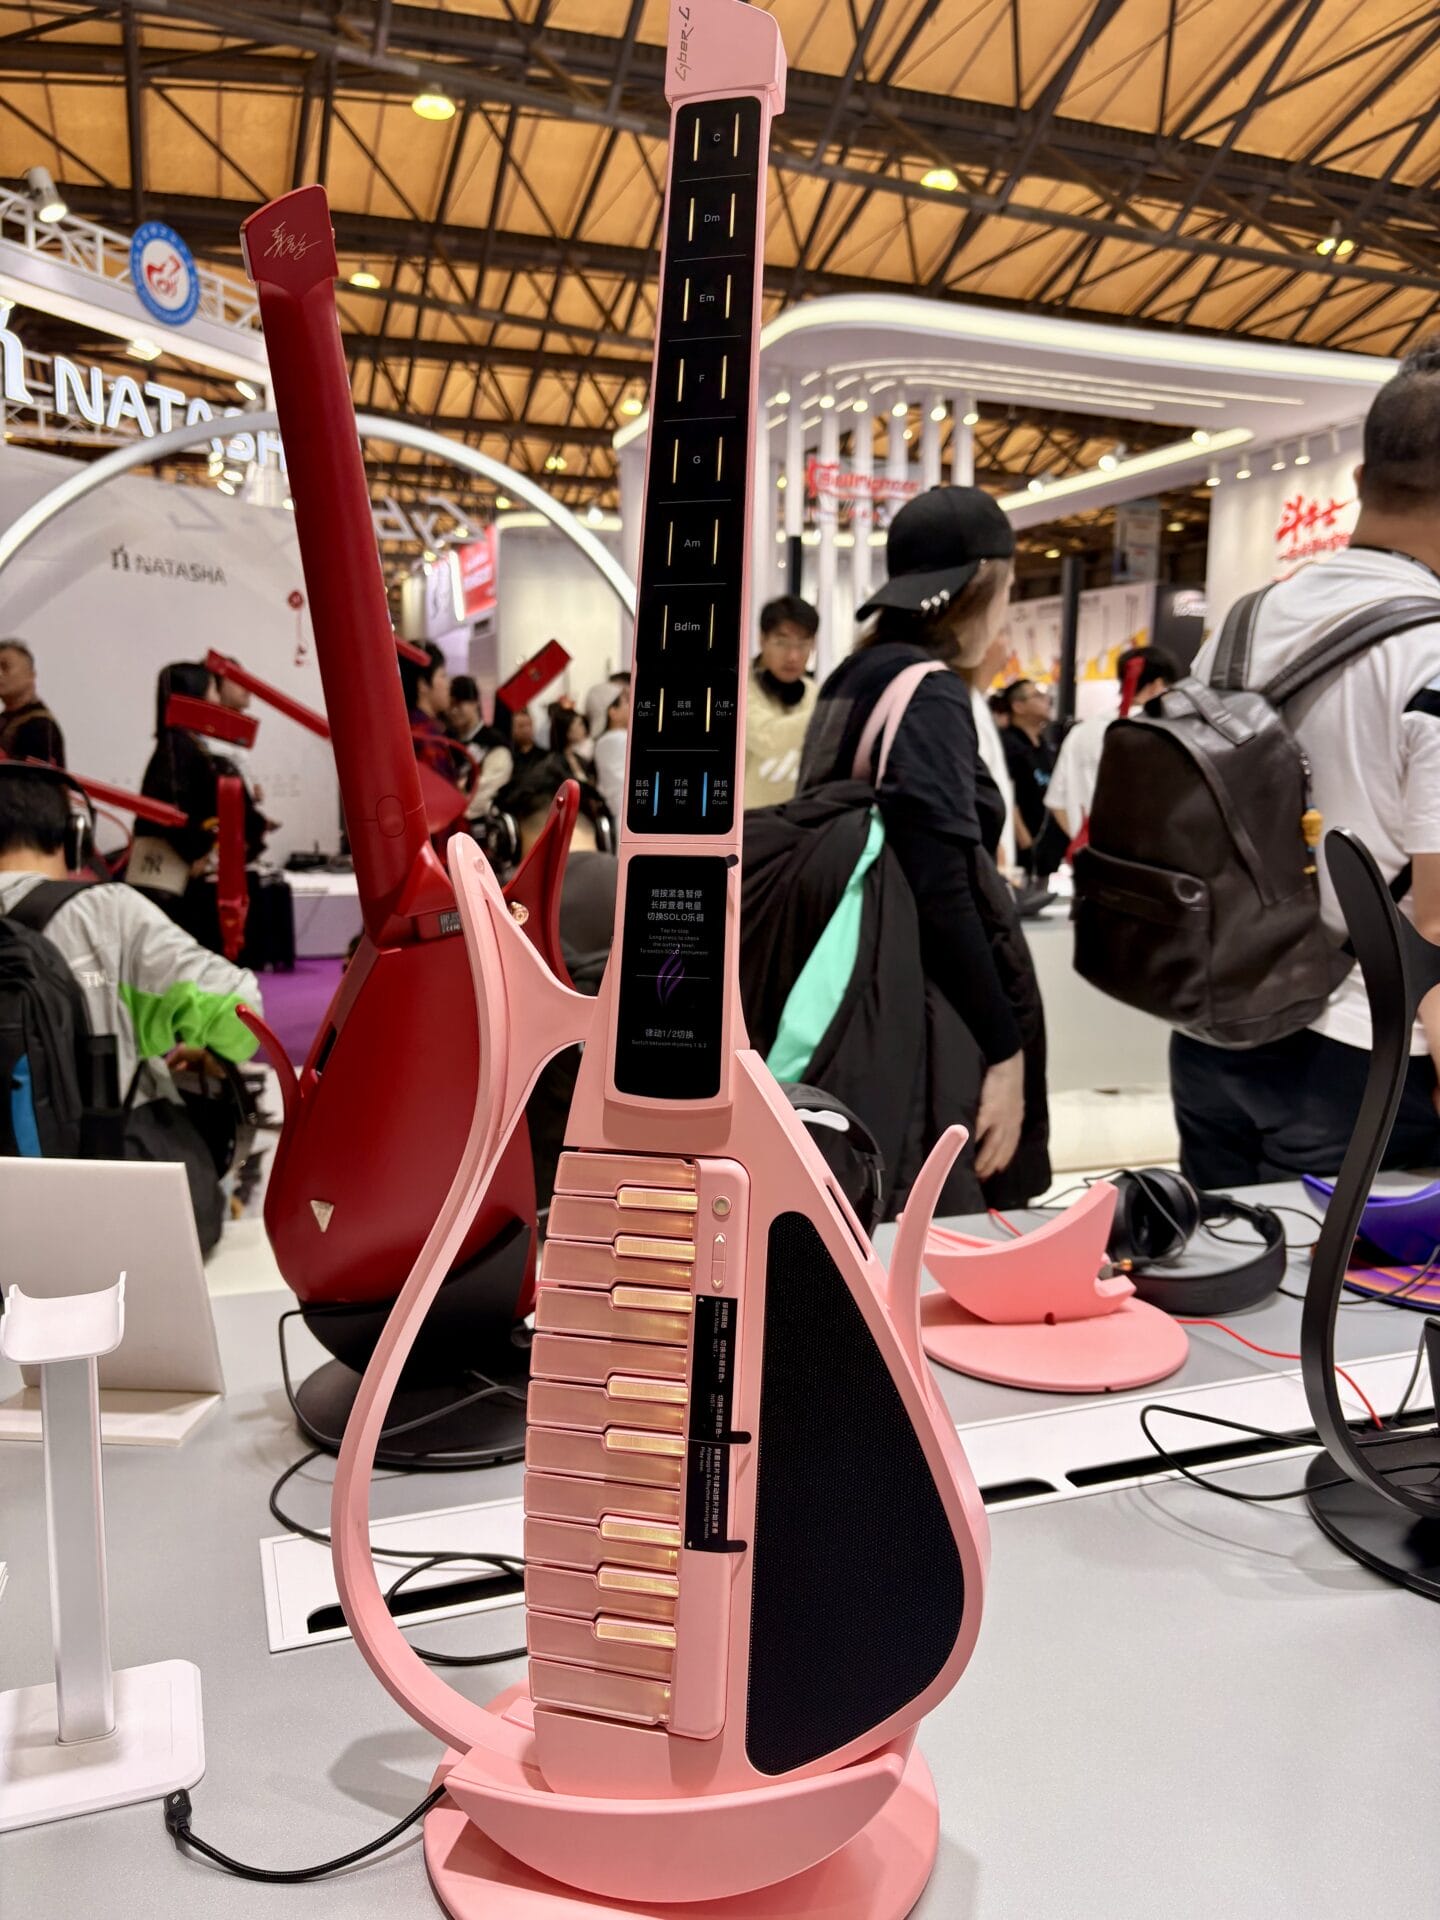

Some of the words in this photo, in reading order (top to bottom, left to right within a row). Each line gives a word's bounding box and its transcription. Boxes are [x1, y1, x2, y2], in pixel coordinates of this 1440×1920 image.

[713, 133, 721, 142] C
[704, 213, 720, 223] Dm
[700, 293, 715, 303] Em
[698, 374, 705, 383] F
[54, 355, 287, 472] NATASH
[692, 455, 701, 464] G
[684, 538, 701, 548] Am
[135, 553, 227, 586] NATASHA
[674, 622, 701, 631] Bdim
